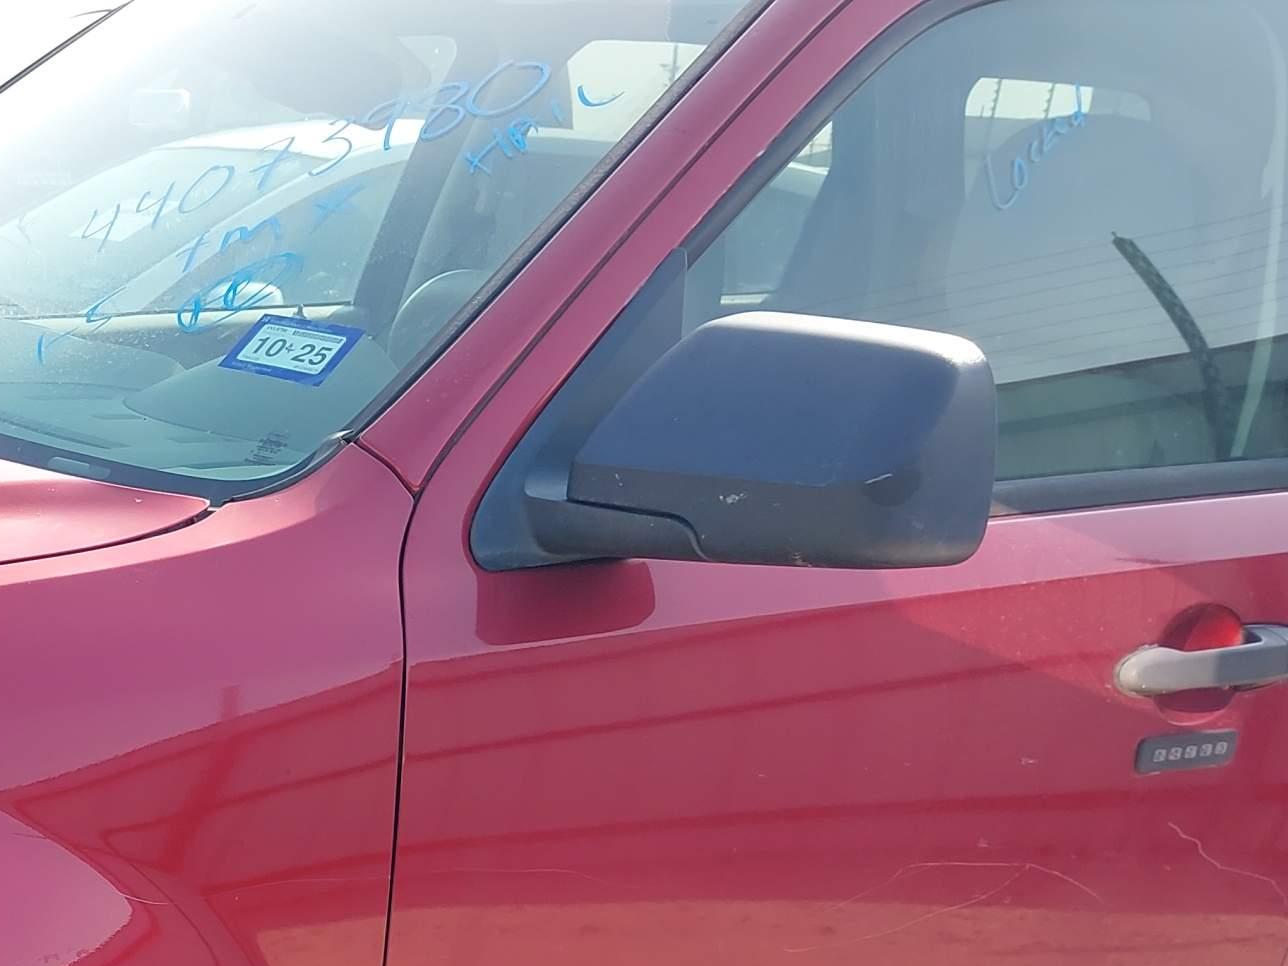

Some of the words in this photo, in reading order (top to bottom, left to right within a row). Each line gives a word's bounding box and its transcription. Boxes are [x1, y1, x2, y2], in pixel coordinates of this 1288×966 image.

[80, 60, 551, 253] 44073980
[252, 336, 288, 358] 10
[290, 343, 334, 366] 25
